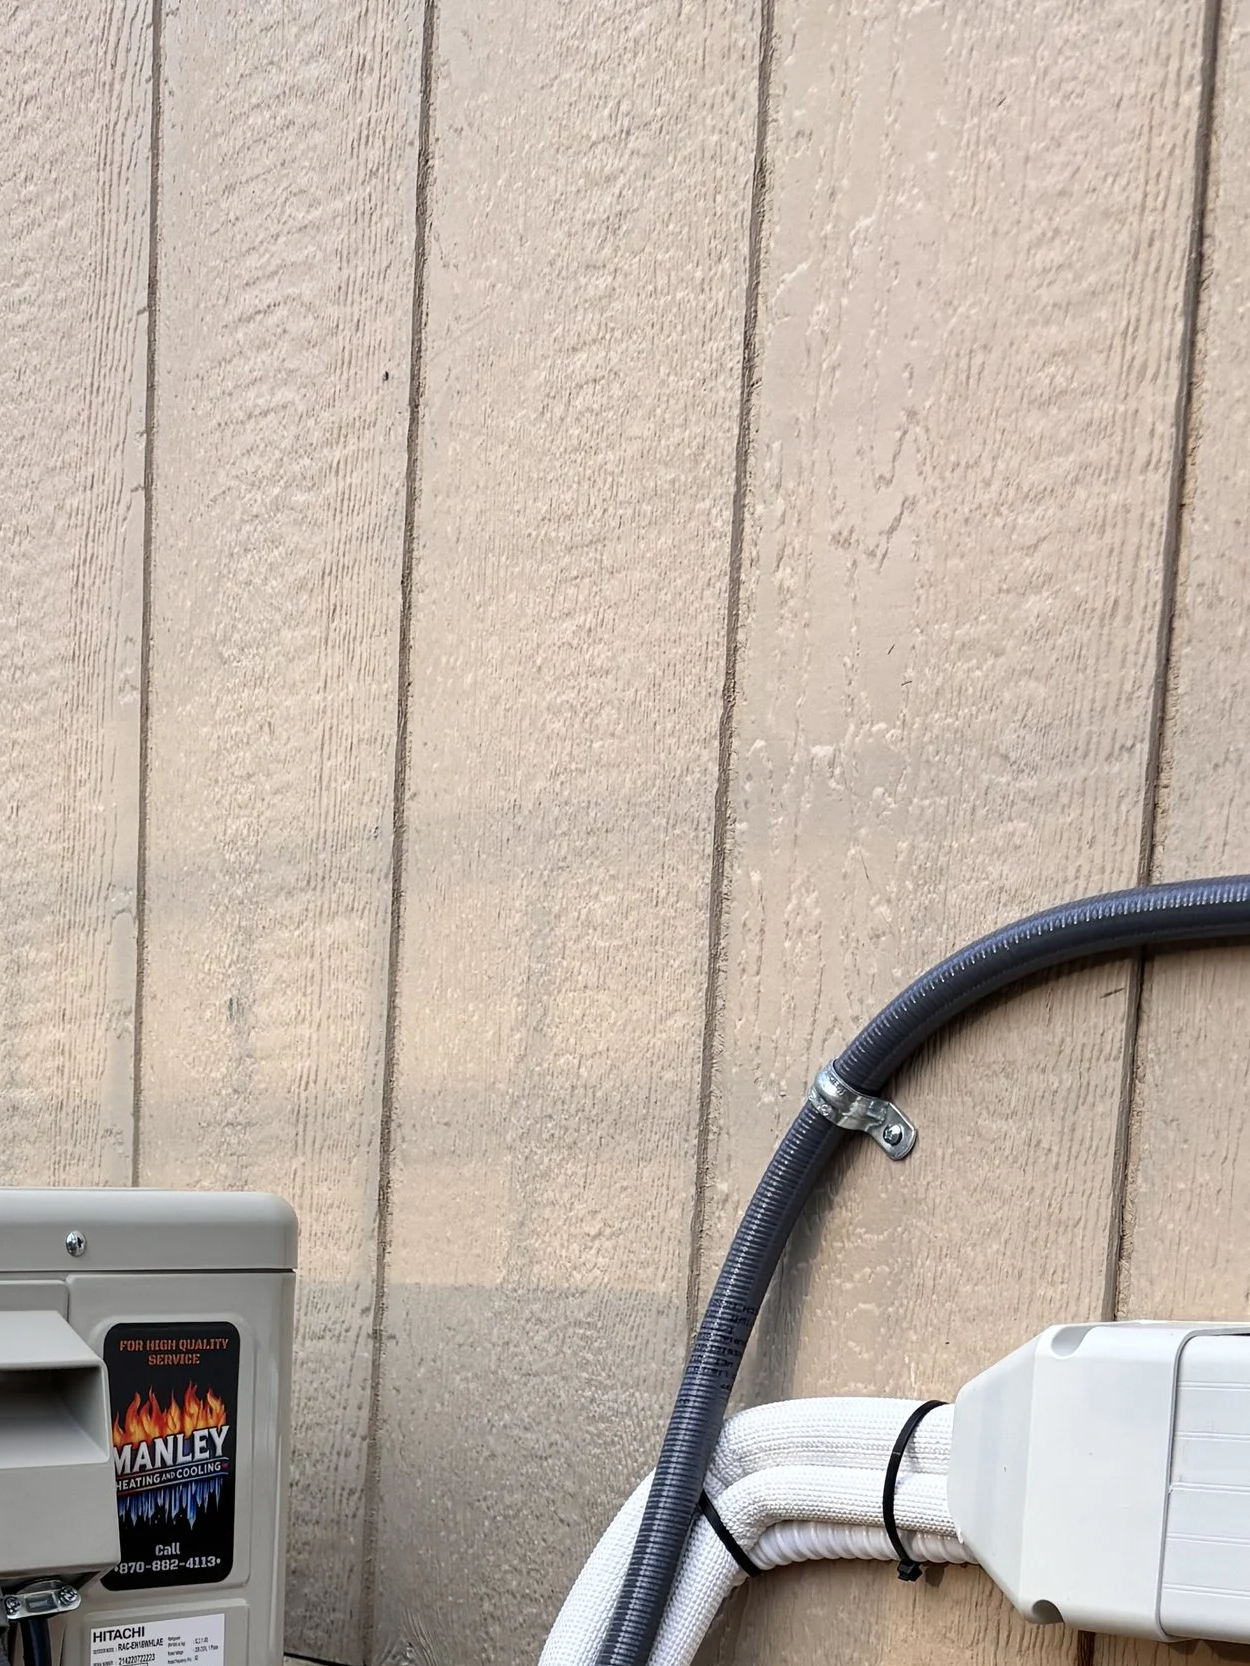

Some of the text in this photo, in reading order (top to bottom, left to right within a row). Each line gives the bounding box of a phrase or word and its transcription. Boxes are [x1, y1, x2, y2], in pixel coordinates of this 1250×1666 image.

[119, 1338, 229, 1351] FOR HIGH QUALITY
[148, 1353, 200, 1366] SERVICE
[113, 1425, 230, 1475] MANLEY
[116, 1473, 160, 1491] HEATING
[161, 1471, 176, 1481] AND
[176, 1462, 221, 1479] COOLING
[155, 1542, 181, 1556] Call
[93, 1626, 145, 1643] HITACHI
